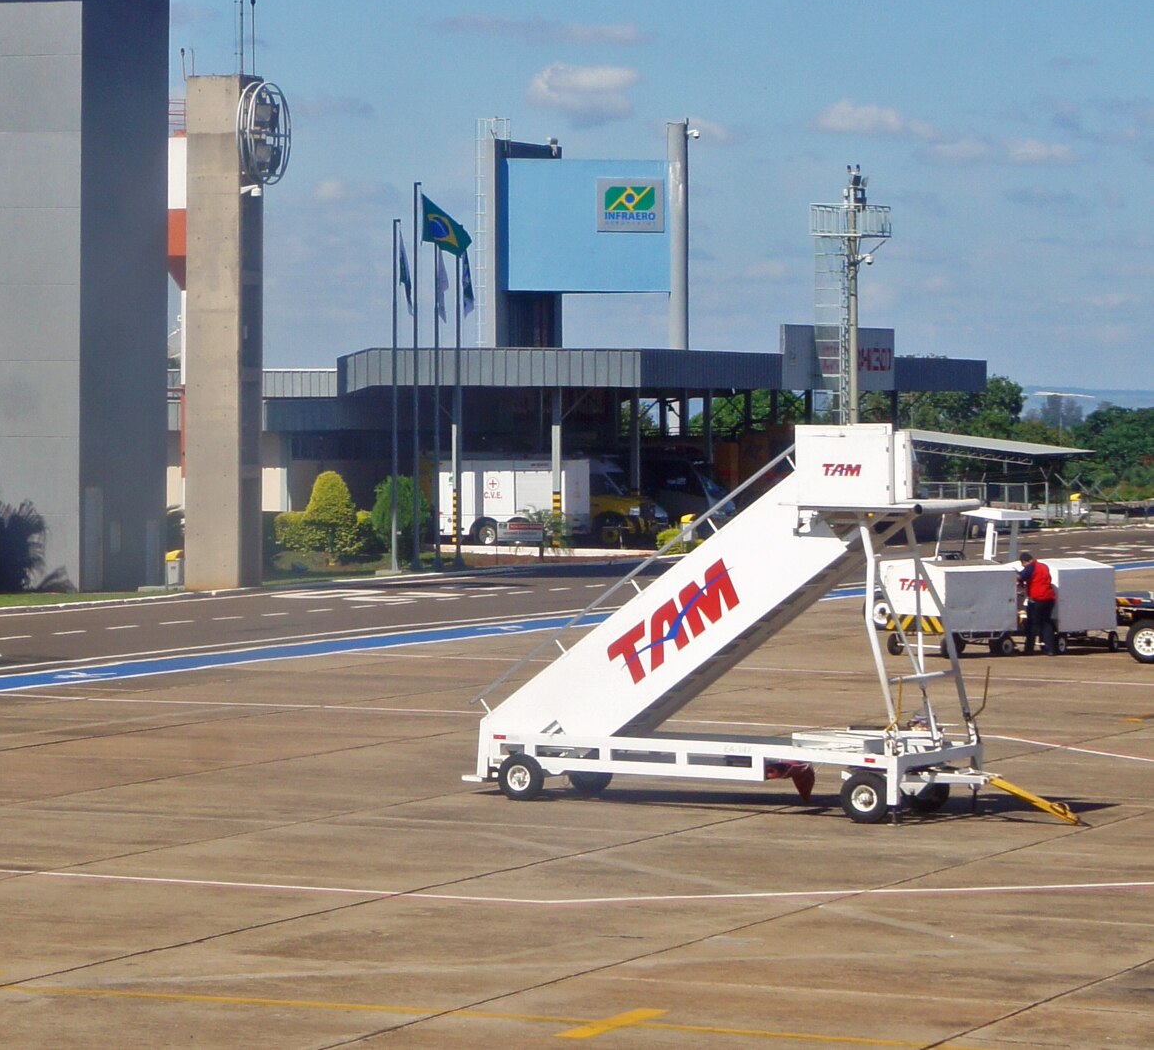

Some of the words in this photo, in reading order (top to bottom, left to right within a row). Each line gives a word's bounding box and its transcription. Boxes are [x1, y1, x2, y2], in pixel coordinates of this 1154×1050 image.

[605, 212, 656, 220] INFRAERO
[822, 463, 862, 477] TAM
[484, 491, 502, 499] C.V.E.
[607, 558, 740, 685] TAM
